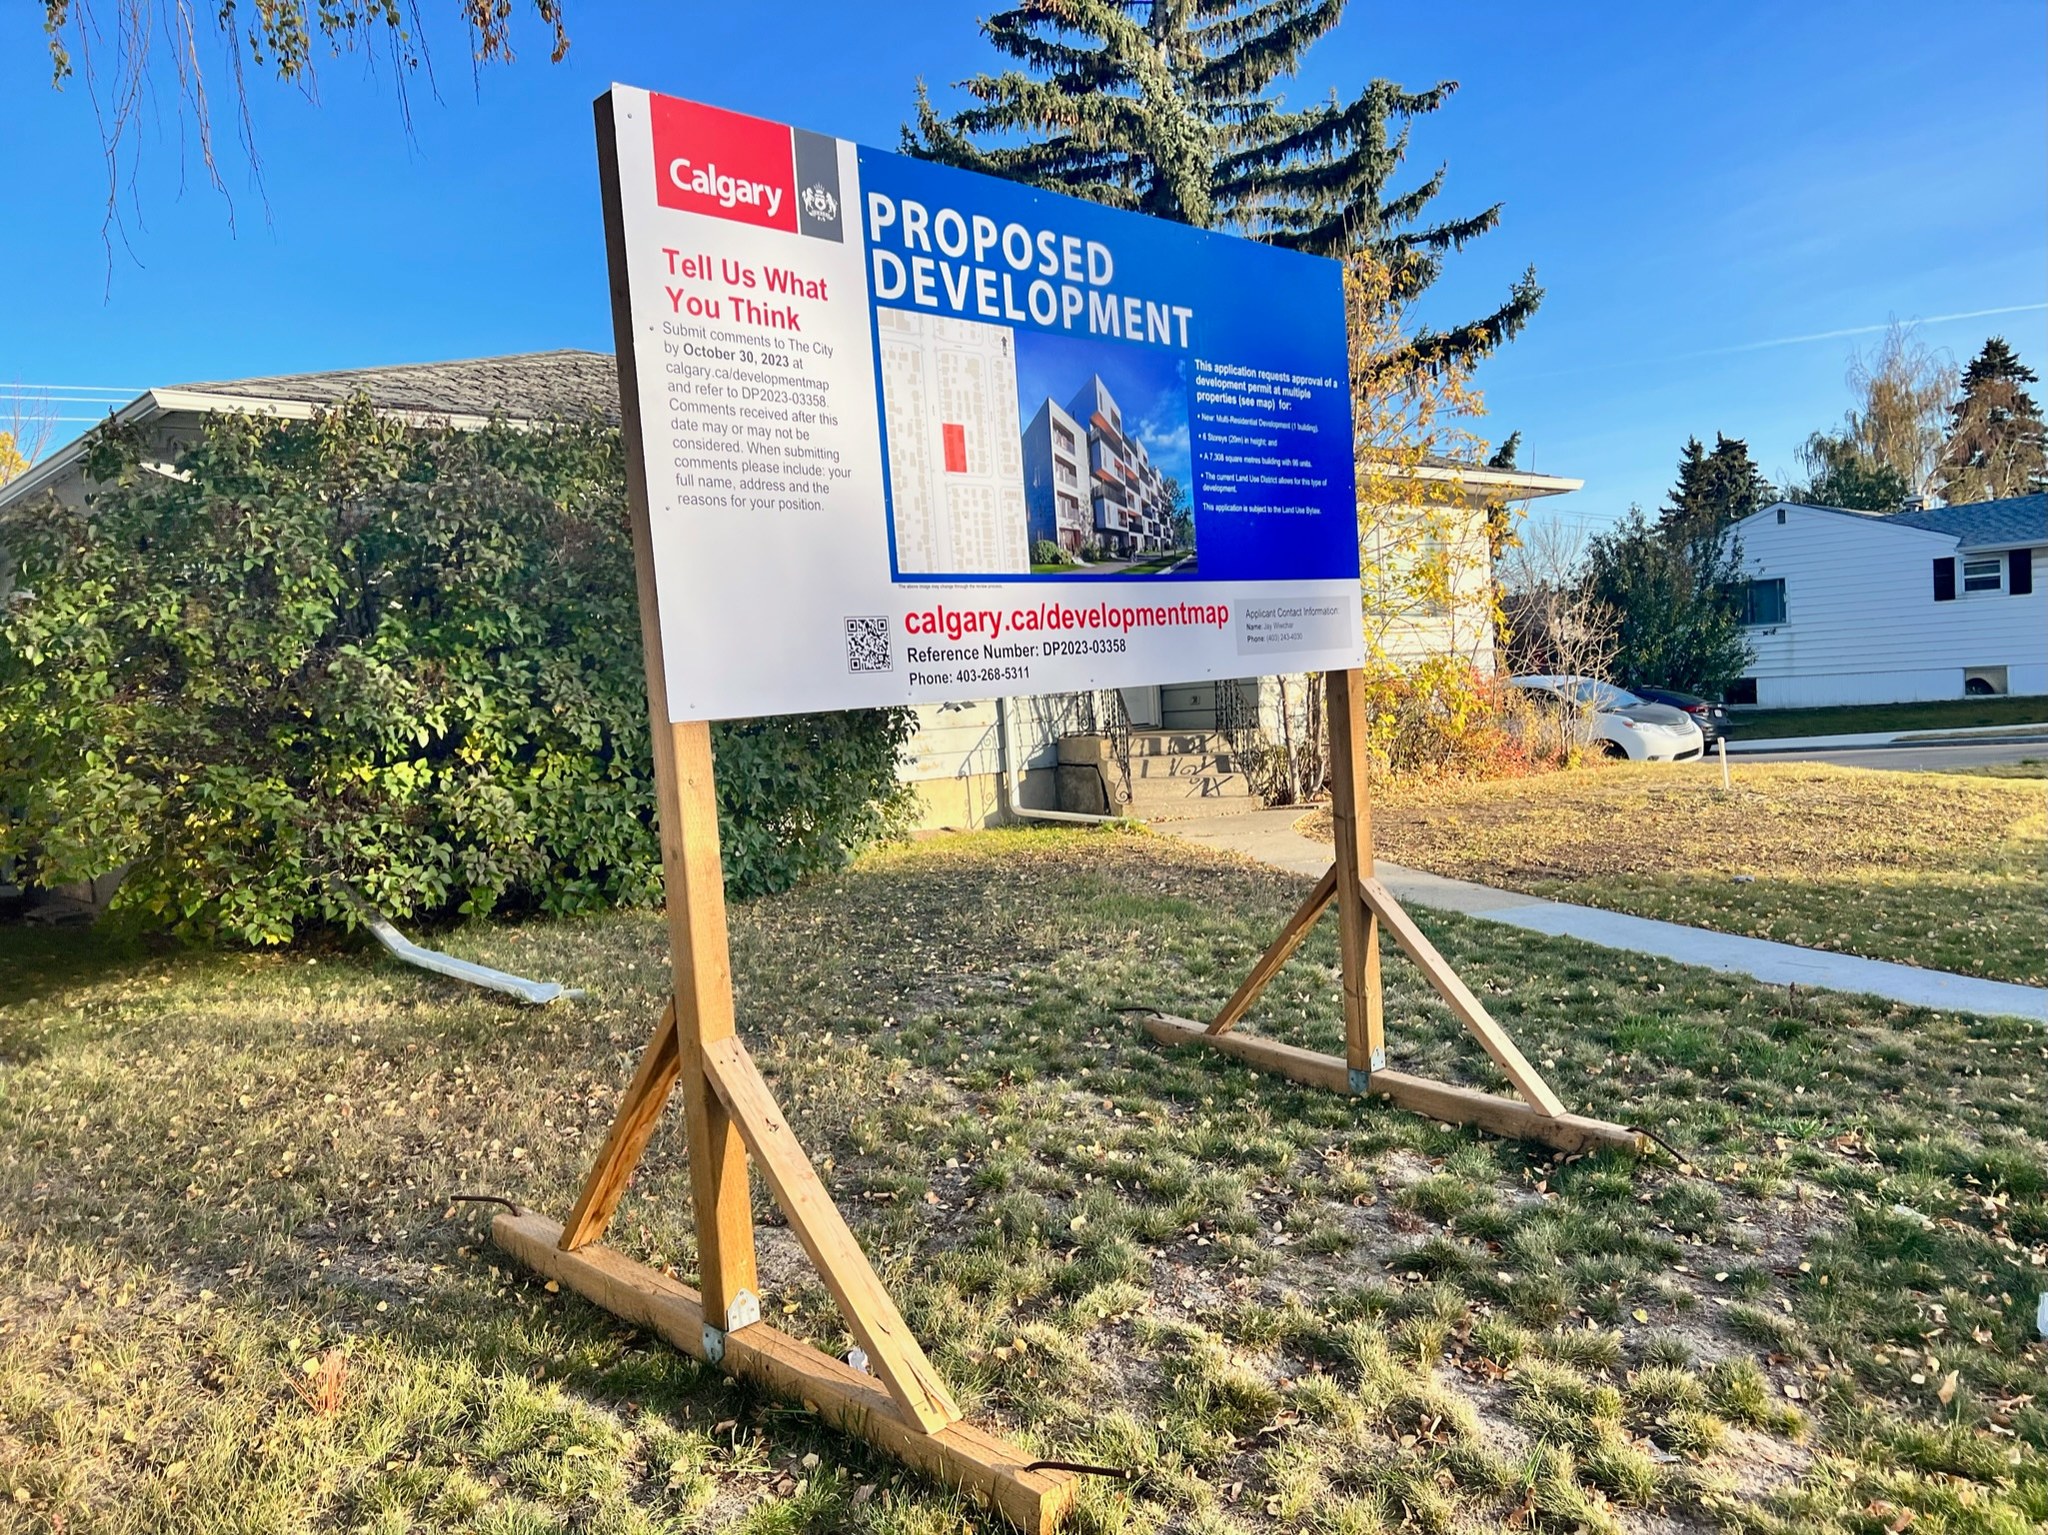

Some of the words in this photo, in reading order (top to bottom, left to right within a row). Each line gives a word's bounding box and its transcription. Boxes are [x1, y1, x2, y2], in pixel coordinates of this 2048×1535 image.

[670, 158, 782, 217] Calgary
[868, 192, 1113, 286] PROPOSED
[662, 248, 712, 282] Tell
[722, 259, 756, 288] Us
[763, 266, 828, 301] What
[665, 286, 720, 319] You
[728, 296, 801, 331] Think
[872, 249, 1192, 348] DEVELOPMENT
[663, 321, 706, 339] Submit
[710, 330, 771, 348] comments
[774, 336, 785, 349] to
[788, 338, 809, 353] The
[813, 342, 833, 358] City
[664, 341, 679, 357] by
[684, 343, 735, 361] October
[740, 351, 757, 365] 30,
[762, 353, 789, 368] 2023
[793, 359, 803, 369] at
[666, 362, 829, 392] calgary.ca/developmentmap
[1195, 359, 1212, 372] This
[1215, 364, 1256, 378] application
[1258, 370, 1290, 382] requests
[1292, 374, 1323, 386] approval
[1325, 378, 1332, 388] of
[1333, 380, 1337, 389] a
[668, 381, 691, 393] and
[696, 384, 723, 397] refer
[727, 386, 738, 398] to
[1196, 375, 1246, 391] development
[1248, 382, 1272, 394] permit
[1274, 386, 1281, 395] at
[1282, 387, 1311, 400] multiple
[669, 398, 736, 416] Comments
[740, 407, 788, 421] received
[792, 411, 815, 424] after
[819, 413, 838, 426] this
[1197, 391, 1236, 404] properties
[1239, 395, 1254, 407] (see
[1257, 399, 1275, 411] map)
[1279, 400, 1291, 410] for:
[671, 418, 698, 432] date
[702, 423, 728, 437] may
[732, 425, 744, 435] or
[748, 427, 771, 440] may
[775, 428, 792, 439] not
[796, 428, 809, 441] be
[1259, 419, 1290, 429] Development
[673, 437, 743, 453] considered.
[747, 441, 781, 456] When
[784, 445, 839, 463] submitting
[1262, 457, 1280, 467] building
[1282, 458, 1291, 466] with
[675, 456, 738, 471] comments
[742, 460, 779, 475] please
[783, 463, 825, 477] include:
[828, 468, 851, 480] your
[1206, 472, 1215, 480] The
[1236, 474, 1248, 482] Land
[1249, 475, 1259, 483] Use
[1311, 479, 1321, 487] type
[676, 473, 694, 487] full
[698, 477, 736, 490] name,
[740, 478, 785, 492] address
[789, 481, 809, 494] and
[813, 482, 829, 494] the
[678, 495, 727, 507] reasons
[731, 495, 746, 508] for
[751, 499, 775, 510] your
[779, 498, 824, 512] position.
[1203, 502, 1214, 511] This
[1215, 504, 1242, 512] application
[1249, 505, 1266, 514] subject
[905, 602, 1228, 641] calgary.ca/developmentmap
[1246, 609, 1276, 620] Applicant
[1277, 608, 1302, 618] Contact
[907, 647, 979, 663] Reference
[984, 643, 1039, 660] Number:
[1043, 639, 1126, 656] DP2023-03358
[909, 671, 952, 686] Phone:
[956, 666, 1030, 682] 403-268-5311
